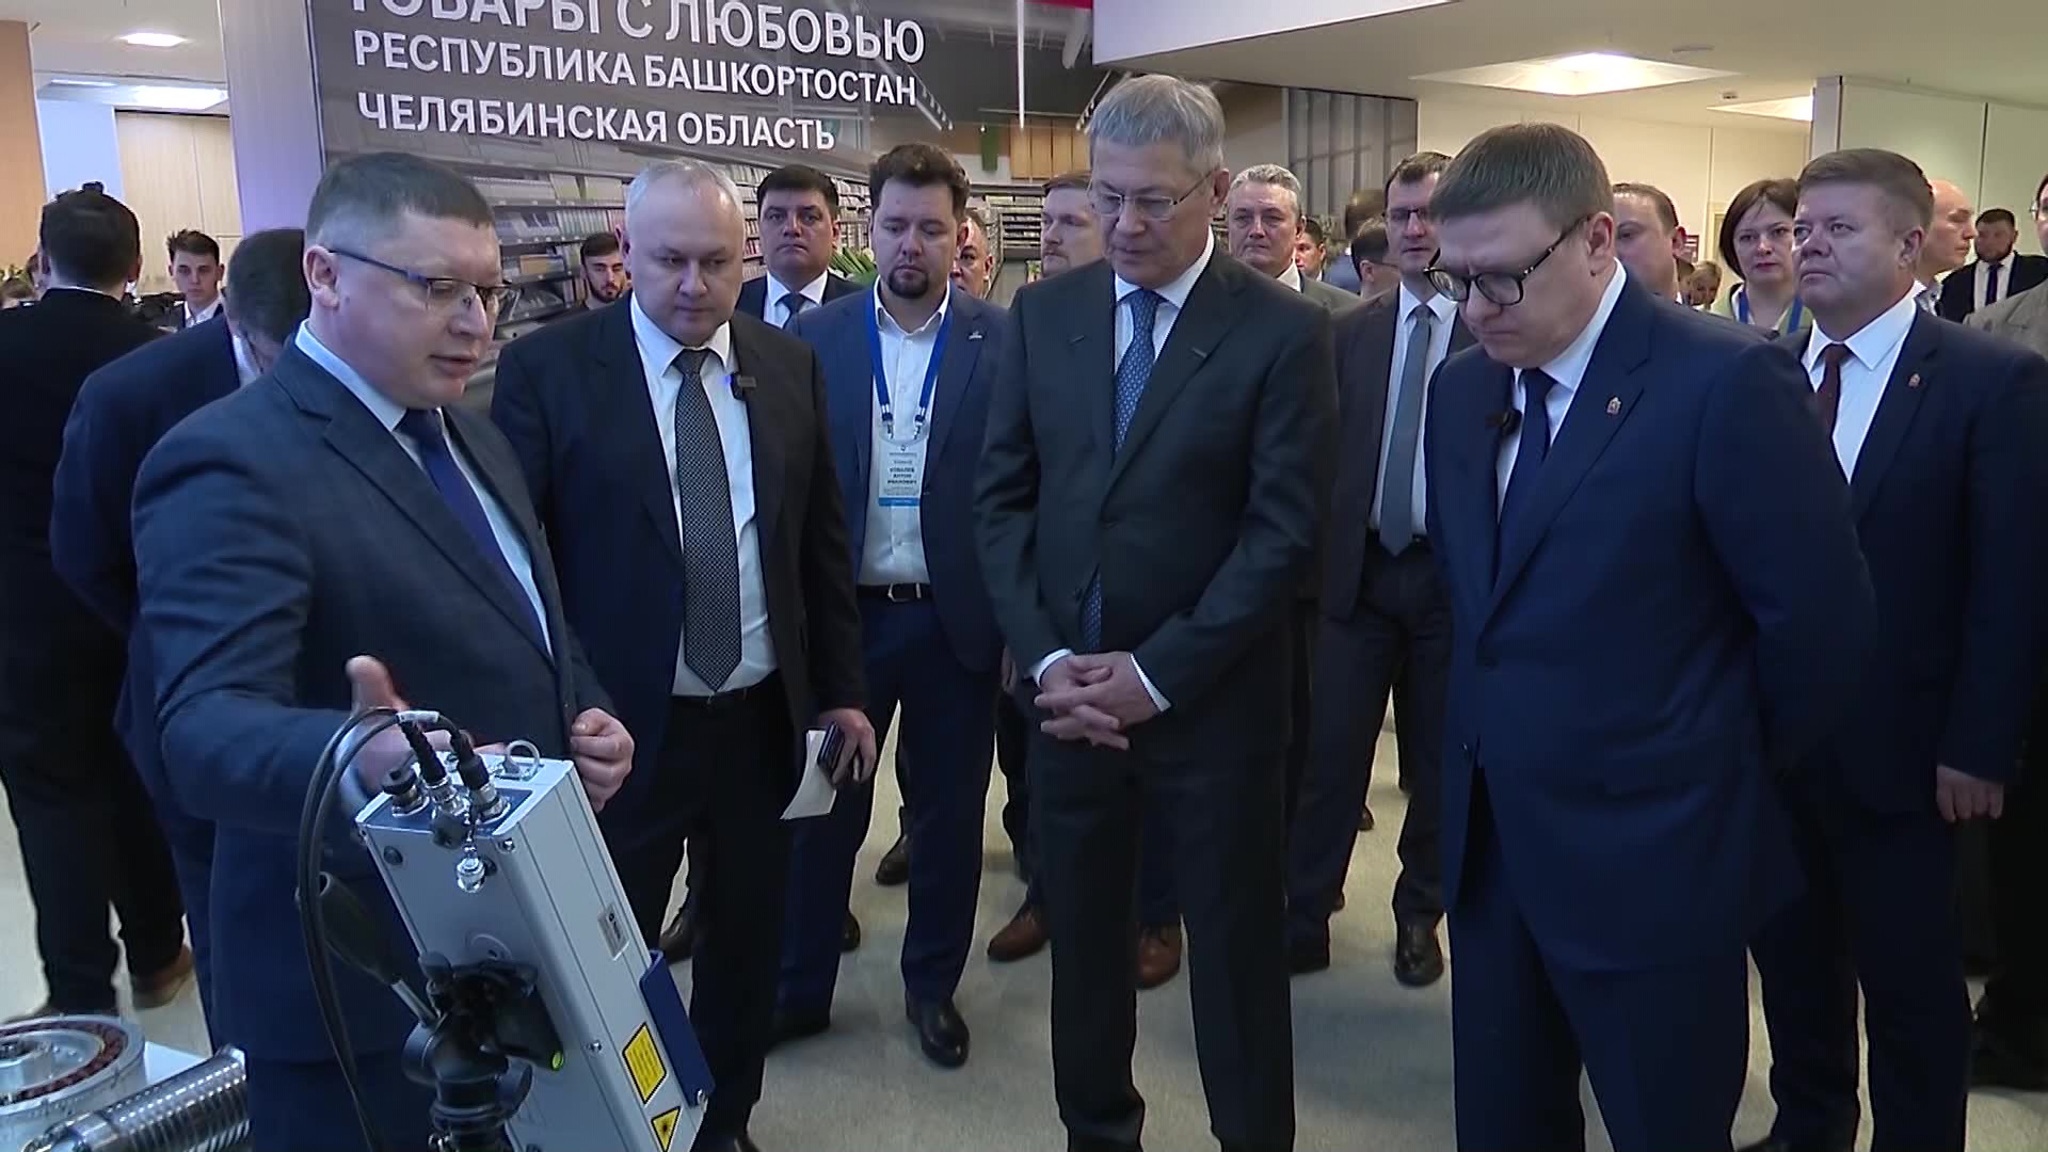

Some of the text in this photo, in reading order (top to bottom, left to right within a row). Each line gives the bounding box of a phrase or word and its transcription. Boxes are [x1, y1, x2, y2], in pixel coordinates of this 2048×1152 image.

[353, 0, 924, 63] АРЫ С ЛЮБОВЬЮ
[354, 29, 916, 106] РЕСПУБЛИКА БАШКОРТОСТАН
[358, 91, 835, 150] ЧЕЛЯБИНСКАЯ ОБЛАСТЬ
